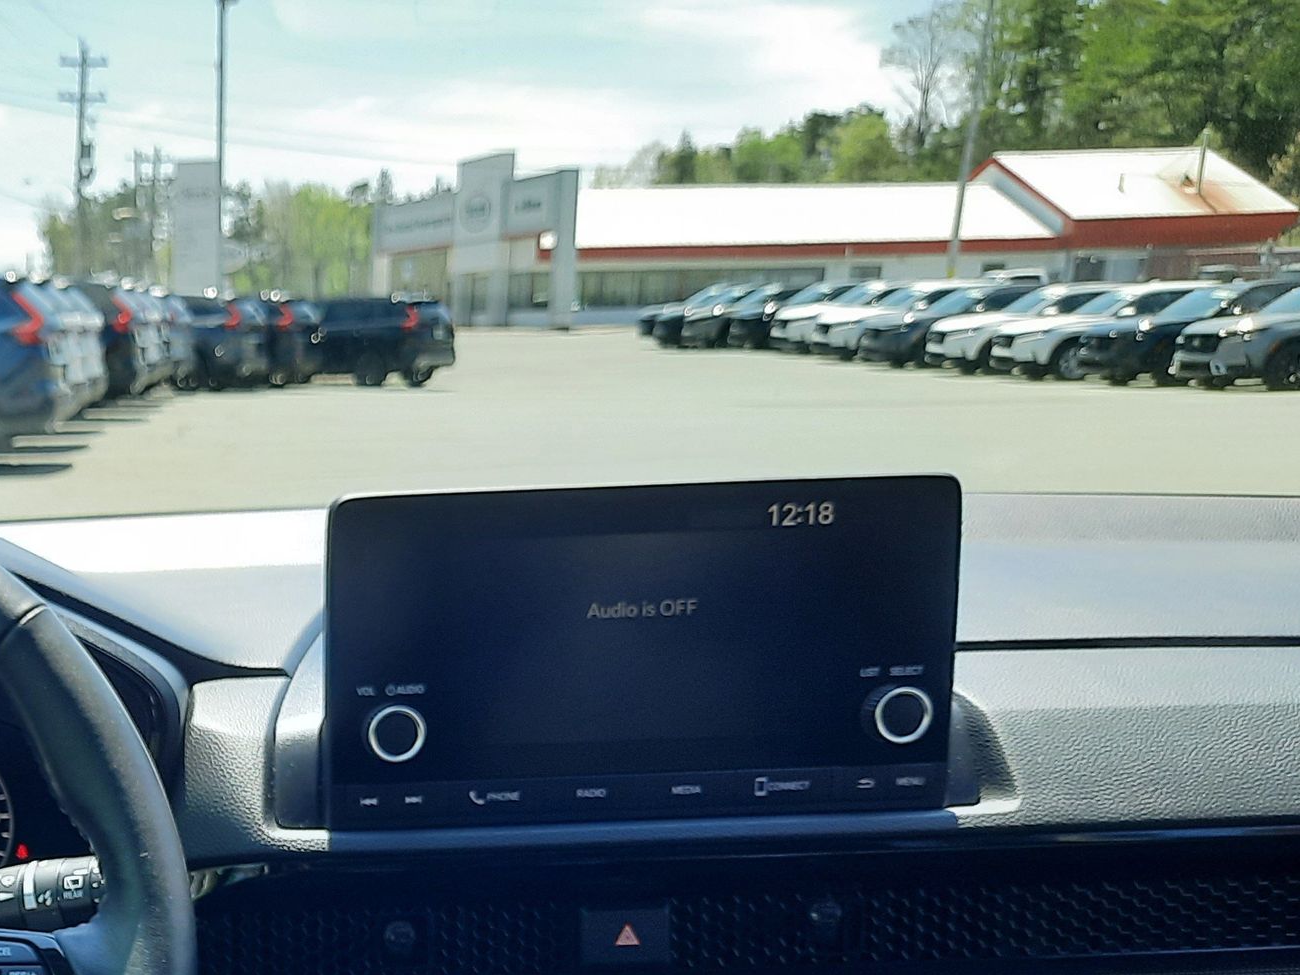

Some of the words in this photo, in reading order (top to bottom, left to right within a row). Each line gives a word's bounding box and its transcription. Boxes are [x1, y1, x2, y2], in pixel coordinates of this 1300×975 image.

[767, 502, 835, 527] 12:18
[587, 602, 637, 619] Audio
[641, 601, 655, 617] is
[660, 599, 698, 617] OFF
[356, 686, 376, 696] VOL
[576, 788, 606, 798] RADIO
